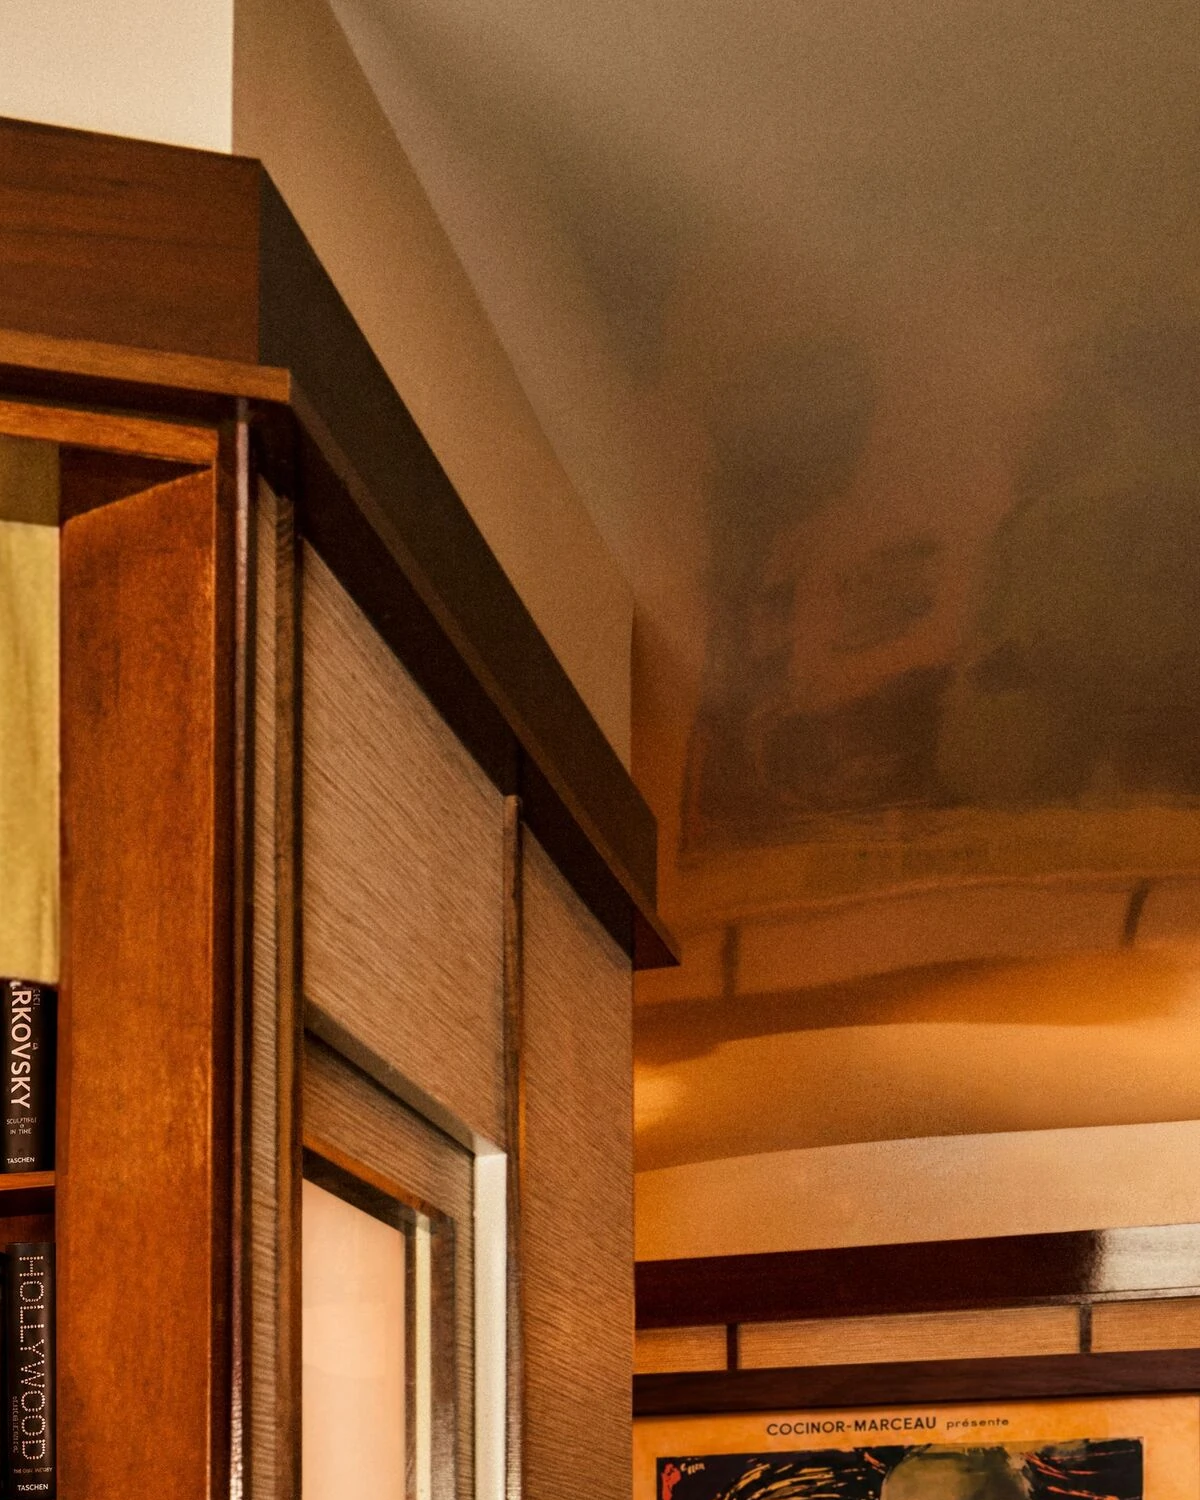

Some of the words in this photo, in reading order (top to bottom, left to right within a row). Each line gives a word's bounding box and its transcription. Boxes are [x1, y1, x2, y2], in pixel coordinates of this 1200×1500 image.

[19, 1255, 46, 1461] HOLLYWOOD
[766, 1416, 937, 1436] COCINOR-MARCEAU
[946, 1417, 1009, 1431] présente
